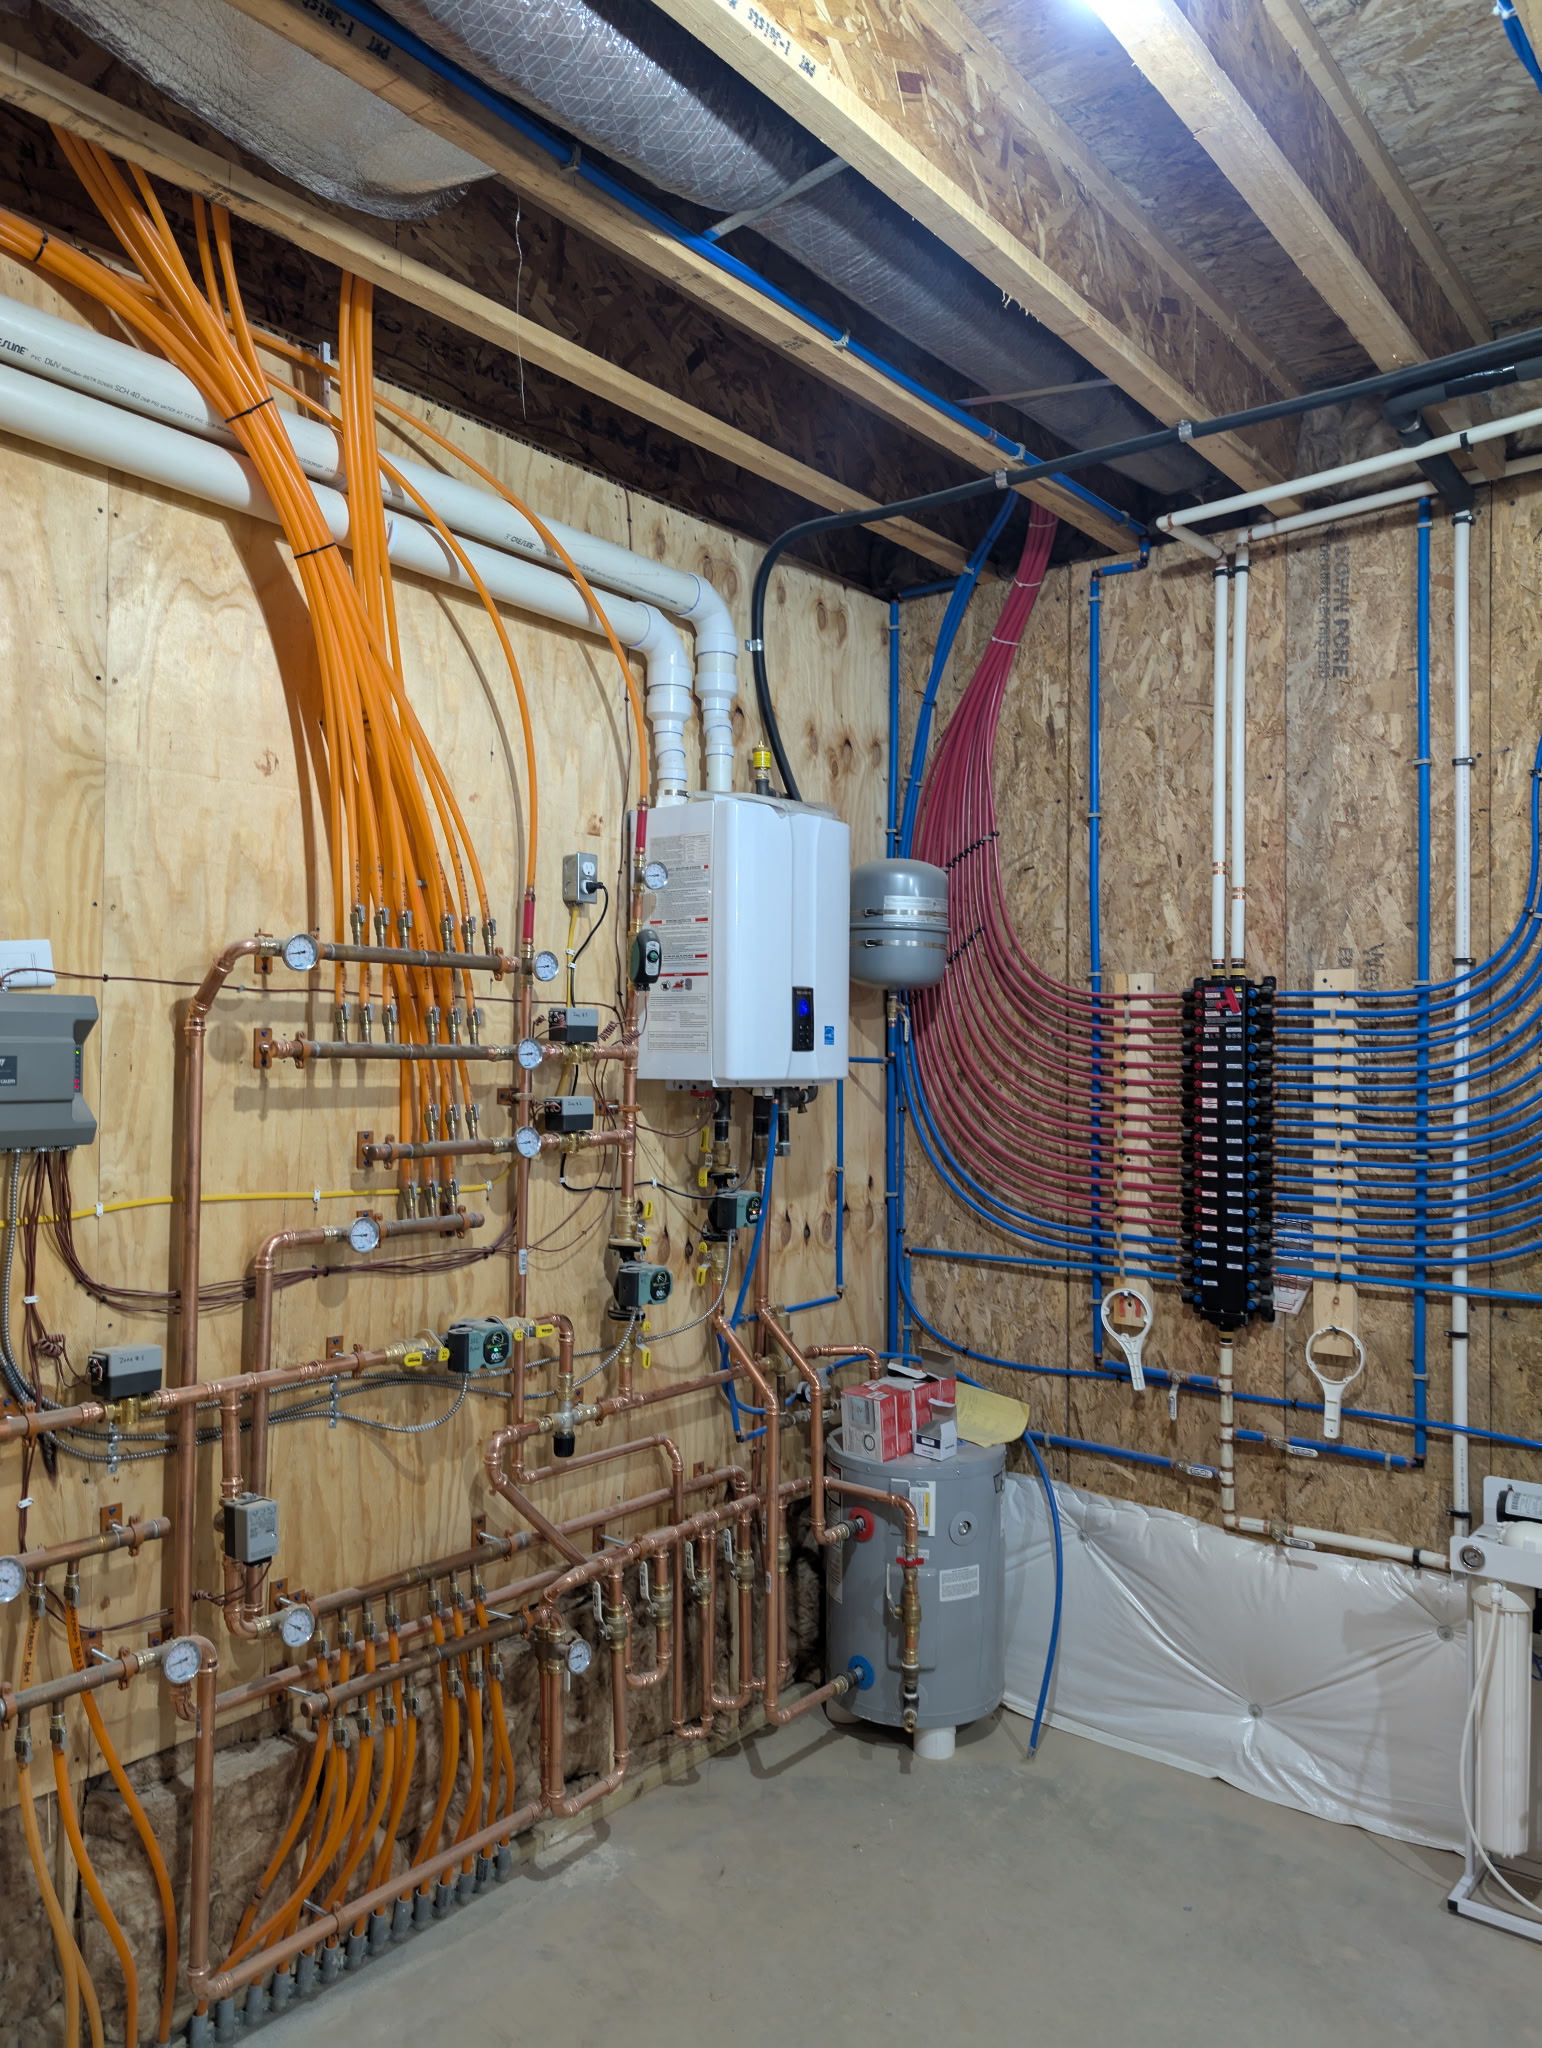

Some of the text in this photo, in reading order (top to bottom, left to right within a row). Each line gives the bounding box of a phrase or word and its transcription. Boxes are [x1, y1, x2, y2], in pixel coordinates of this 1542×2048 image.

[44, 357, 61, 369] DWV
[114, 384, 130, 395] SCH
[130, 391, 141, 400] 40
